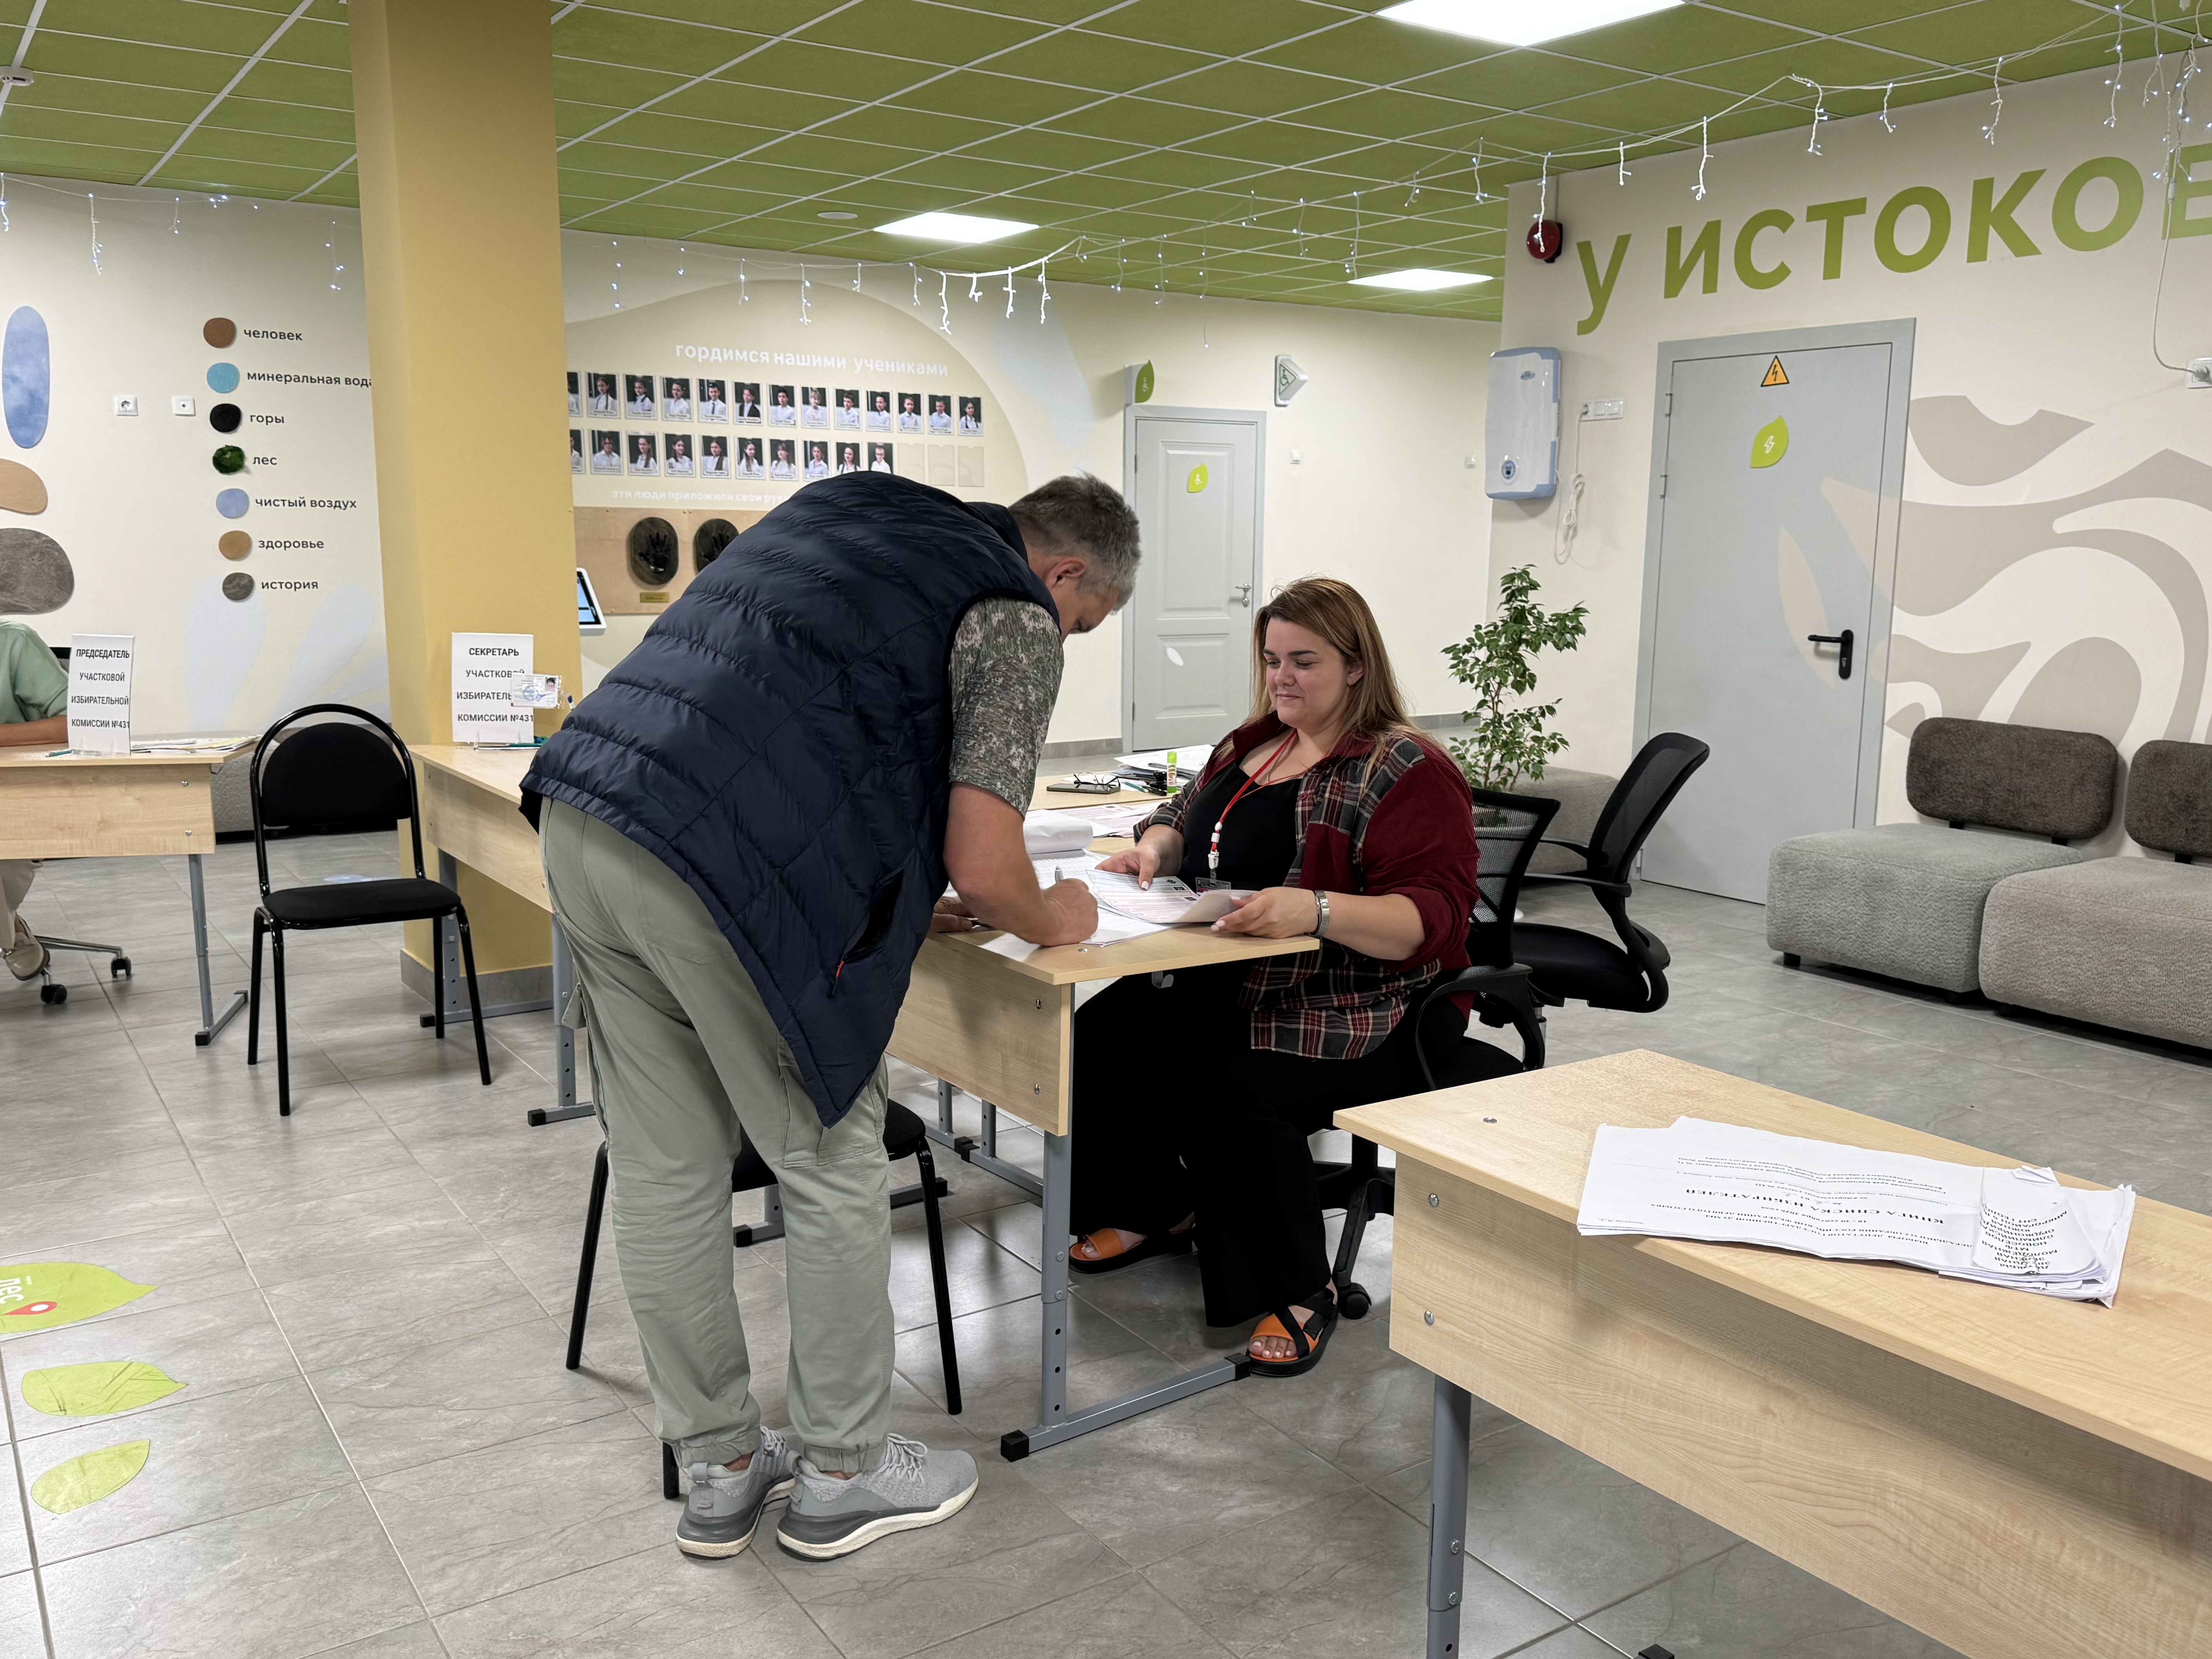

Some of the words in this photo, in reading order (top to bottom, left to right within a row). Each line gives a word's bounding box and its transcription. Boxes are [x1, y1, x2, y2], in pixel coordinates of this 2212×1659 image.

[244, 329, 302, 341] человек
[676, 344, 769, 363] гордимся
[774, 352, 847, 369] нашими
[853, 357, 948, 376] учениками
[247, 371, 340, 385] минеральная
[250, 414, 284, 426] горы
[253, 457, 277, 465] лес
[255, 496, 306, 507] чистый
[310, 500, 357, 510] воздух
[612, 490, 632, 498] эти
[634, 490, 666, 500] люди
[668, 491, 733, 502] приложили
[764, 495, 789, 505] рук
[259, 540, 324, 551] здоровье
[261, 582, 318, 592] история
[76, 649, 130, 659] ПРЕДСЕДАТЕЛЬ
[469, 647, 519, 656] СЕКРЕТАРЬ
[80, 672, 125, 682] УЧАСТКОВОЙ
[466, 670, 524, 678] УЧАСТКОВ
[71, 696, 129, 705] ИЗБИРАТЕЛЬНОЙ
[457, 692, 512, 700] ИЗБИРАТЕЛЬ
[72, 719, 110, 728] КОМИССИИ
[510, 714, 533, 722] №431
[1686, 1189, 1803, 1207] ИЗБИРАТЕЛЕЙ
[1810, 1206, 1880, 1214] СПИСКА
[1886, 1211, 1944, 1224] КНИГА
[2001, 1211, 2067, 1228] МИКРОРАЙОН
[1991, 1219, 2030, 1232] ЮЖНАЯ
[1911, 1234, 1974, 1247] ДЕРАЛЬНОГО
[1985, 1231, 2047, 1247] НОВОСЕЛОВ
